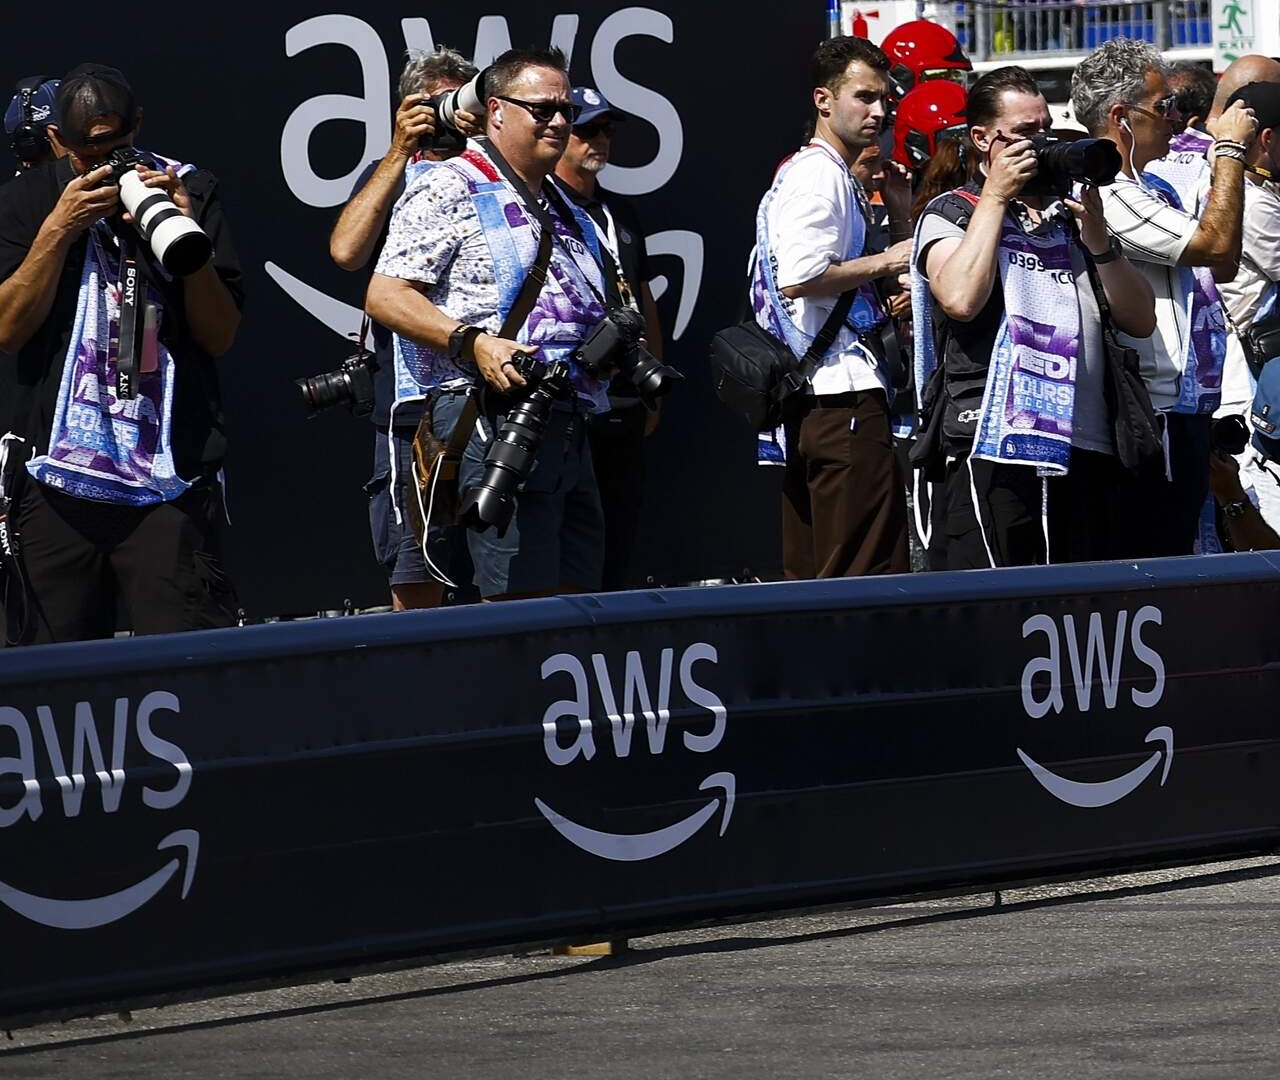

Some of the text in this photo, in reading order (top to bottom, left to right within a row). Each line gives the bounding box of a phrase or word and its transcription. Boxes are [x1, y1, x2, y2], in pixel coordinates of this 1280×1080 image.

[1218, 40, 1254, 49] EXIT
[124, 267, 137, 307] SONY
[1009, 252, 1048, 272] 0399
[1021, 605, 1166, 719] aws
[542, 642, 729, 767] aws
[0, 690, 194, 828] aws
